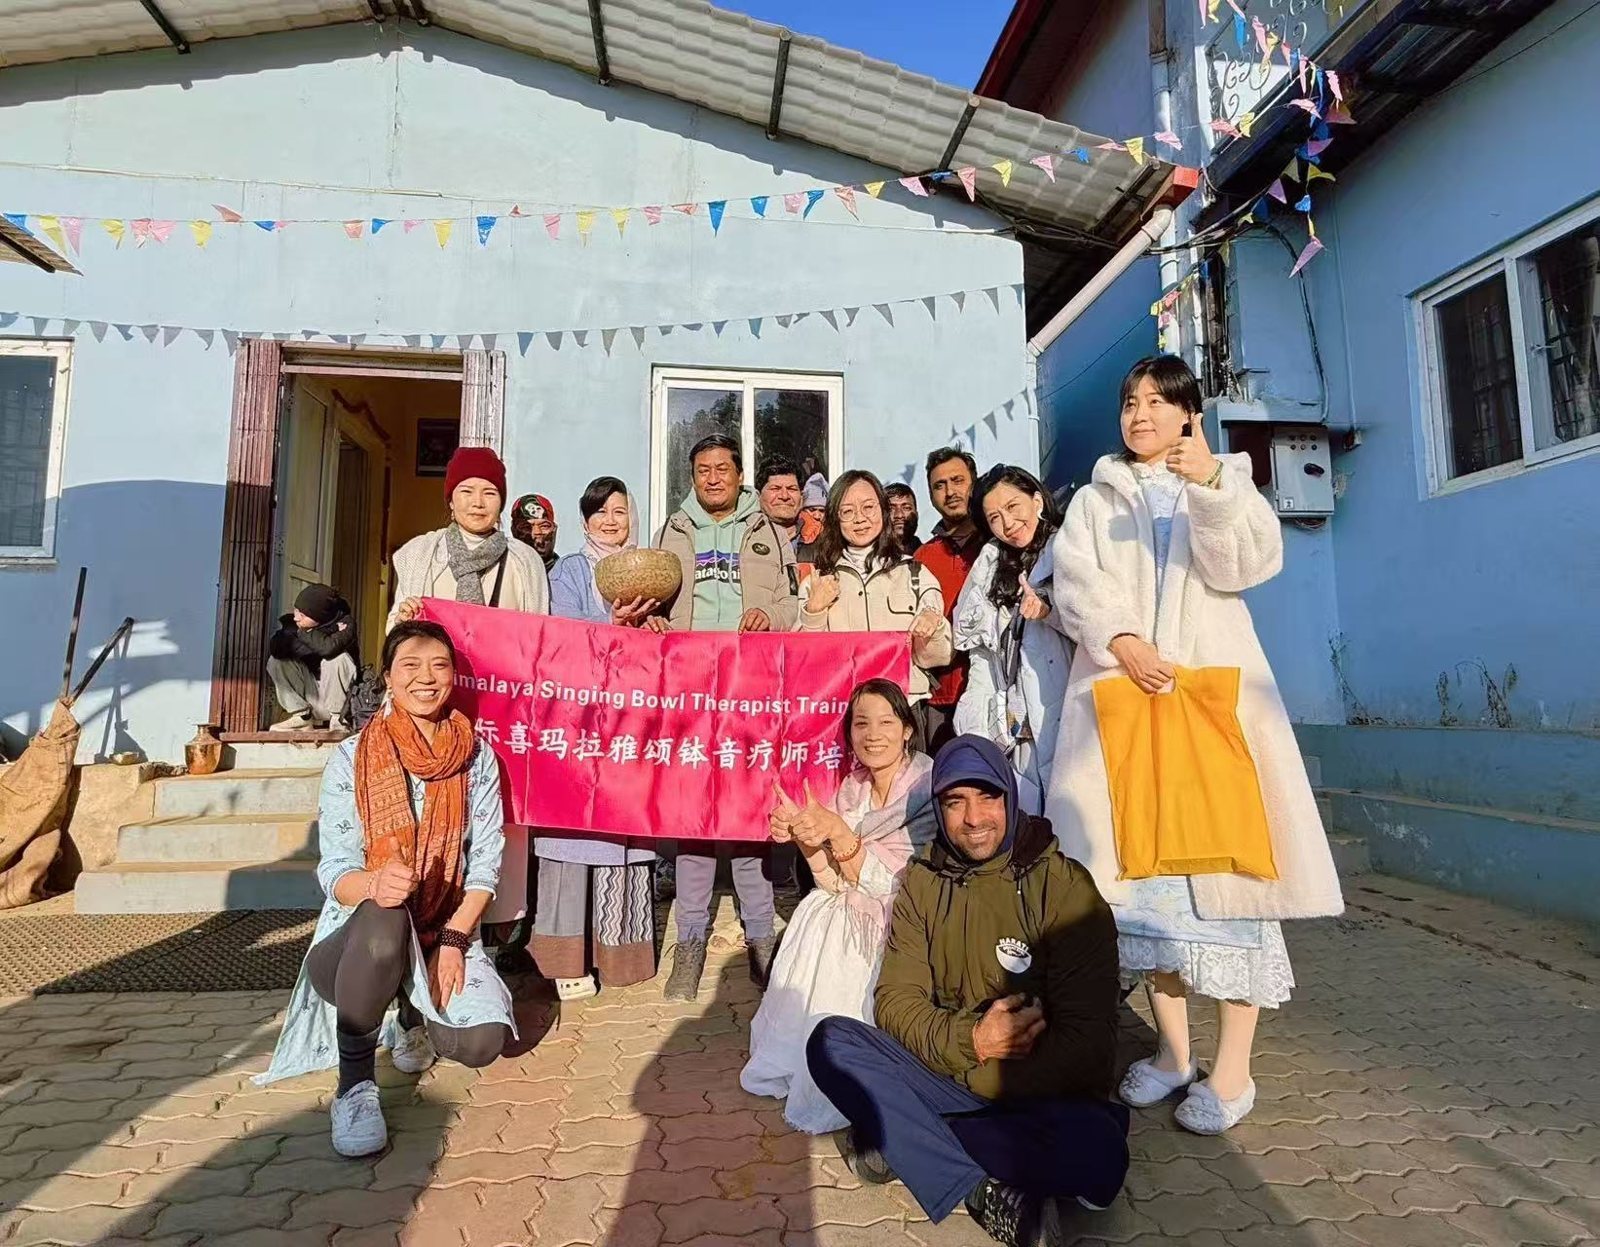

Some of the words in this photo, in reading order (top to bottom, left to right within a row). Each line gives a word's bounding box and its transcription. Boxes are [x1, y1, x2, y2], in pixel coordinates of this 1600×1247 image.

[695, 566, 740, 580] atagoni
[453, 669, 534, 699] imalaya
[540, 680, 625, 710] Singing
[631, 689, 685, 710] Bowl
[691, 693, 791, 716] Therapist
[797, 696, 848, 714] Train
